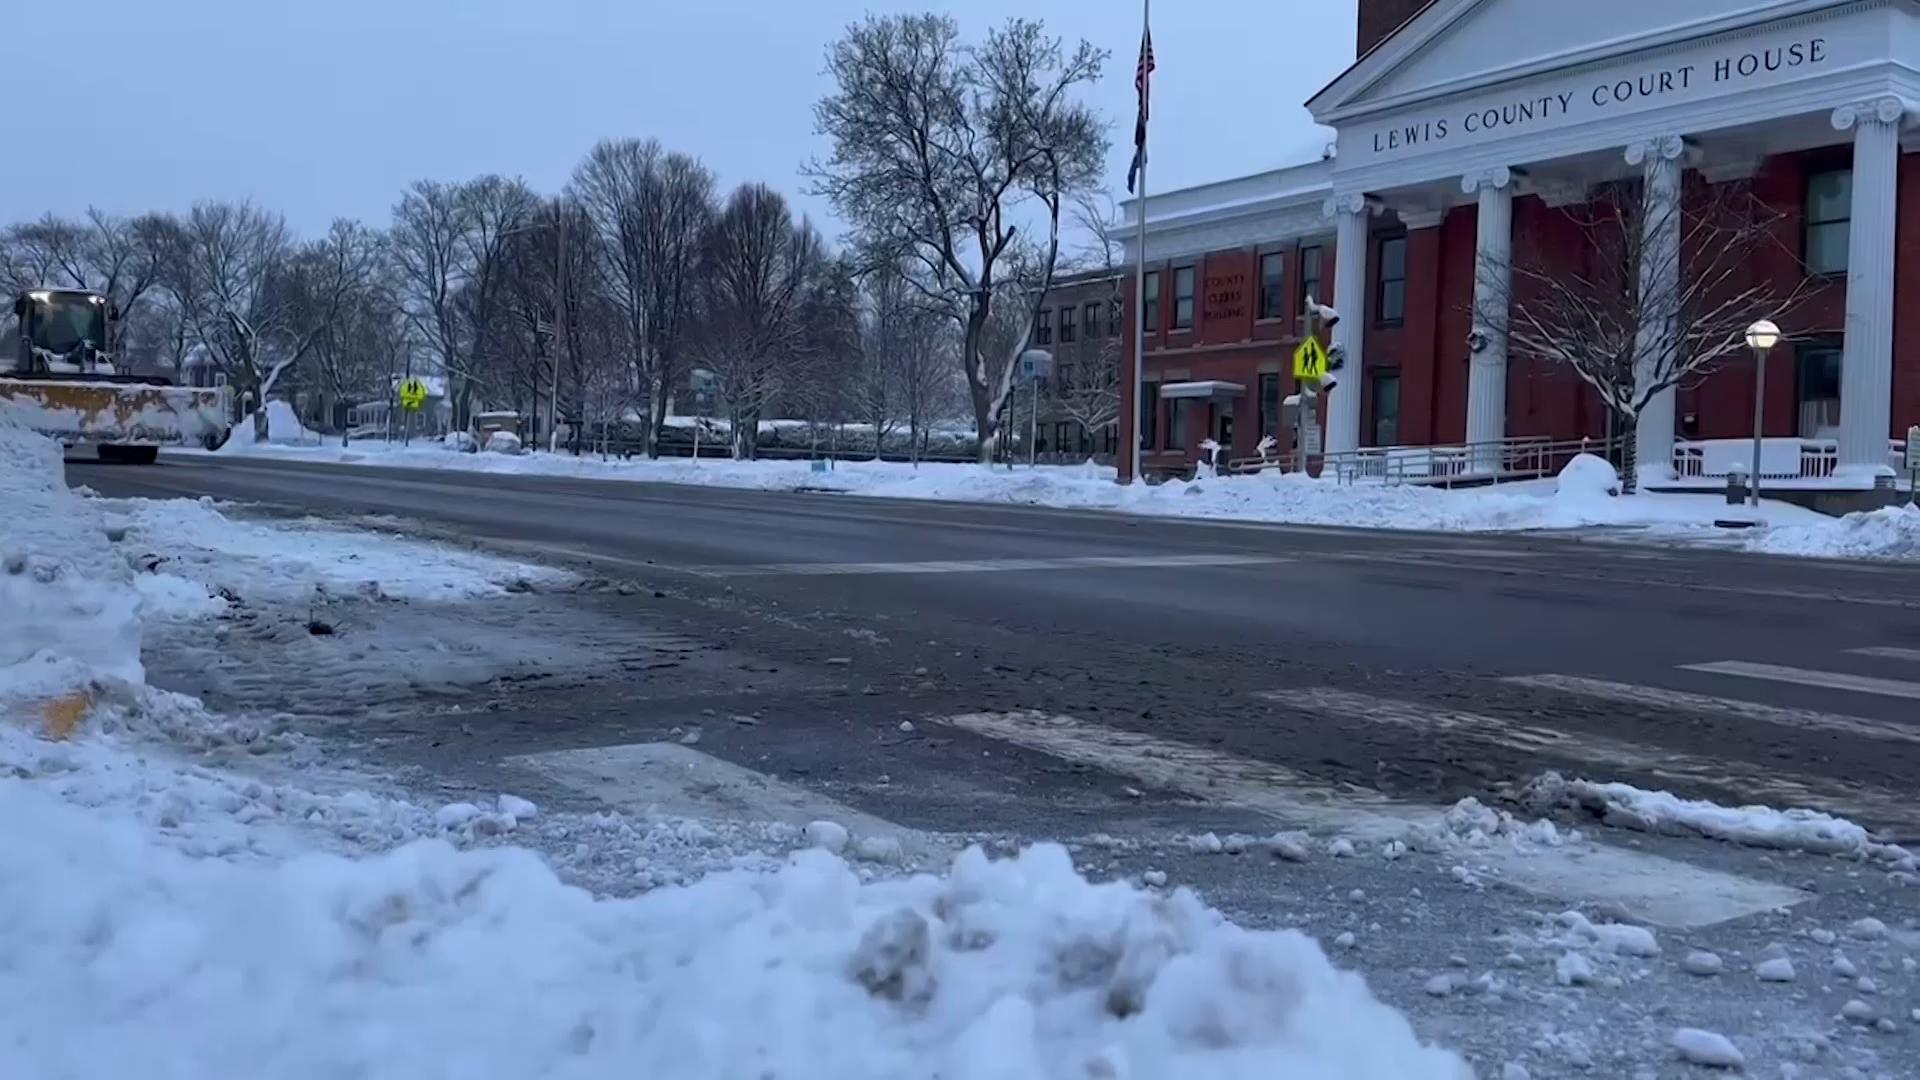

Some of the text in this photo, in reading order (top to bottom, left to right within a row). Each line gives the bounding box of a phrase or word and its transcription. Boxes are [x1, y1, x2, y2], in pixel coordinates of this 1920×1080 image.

[1373, 38, 1826, 153] LEWIS COUNTY COURT HOUSE
